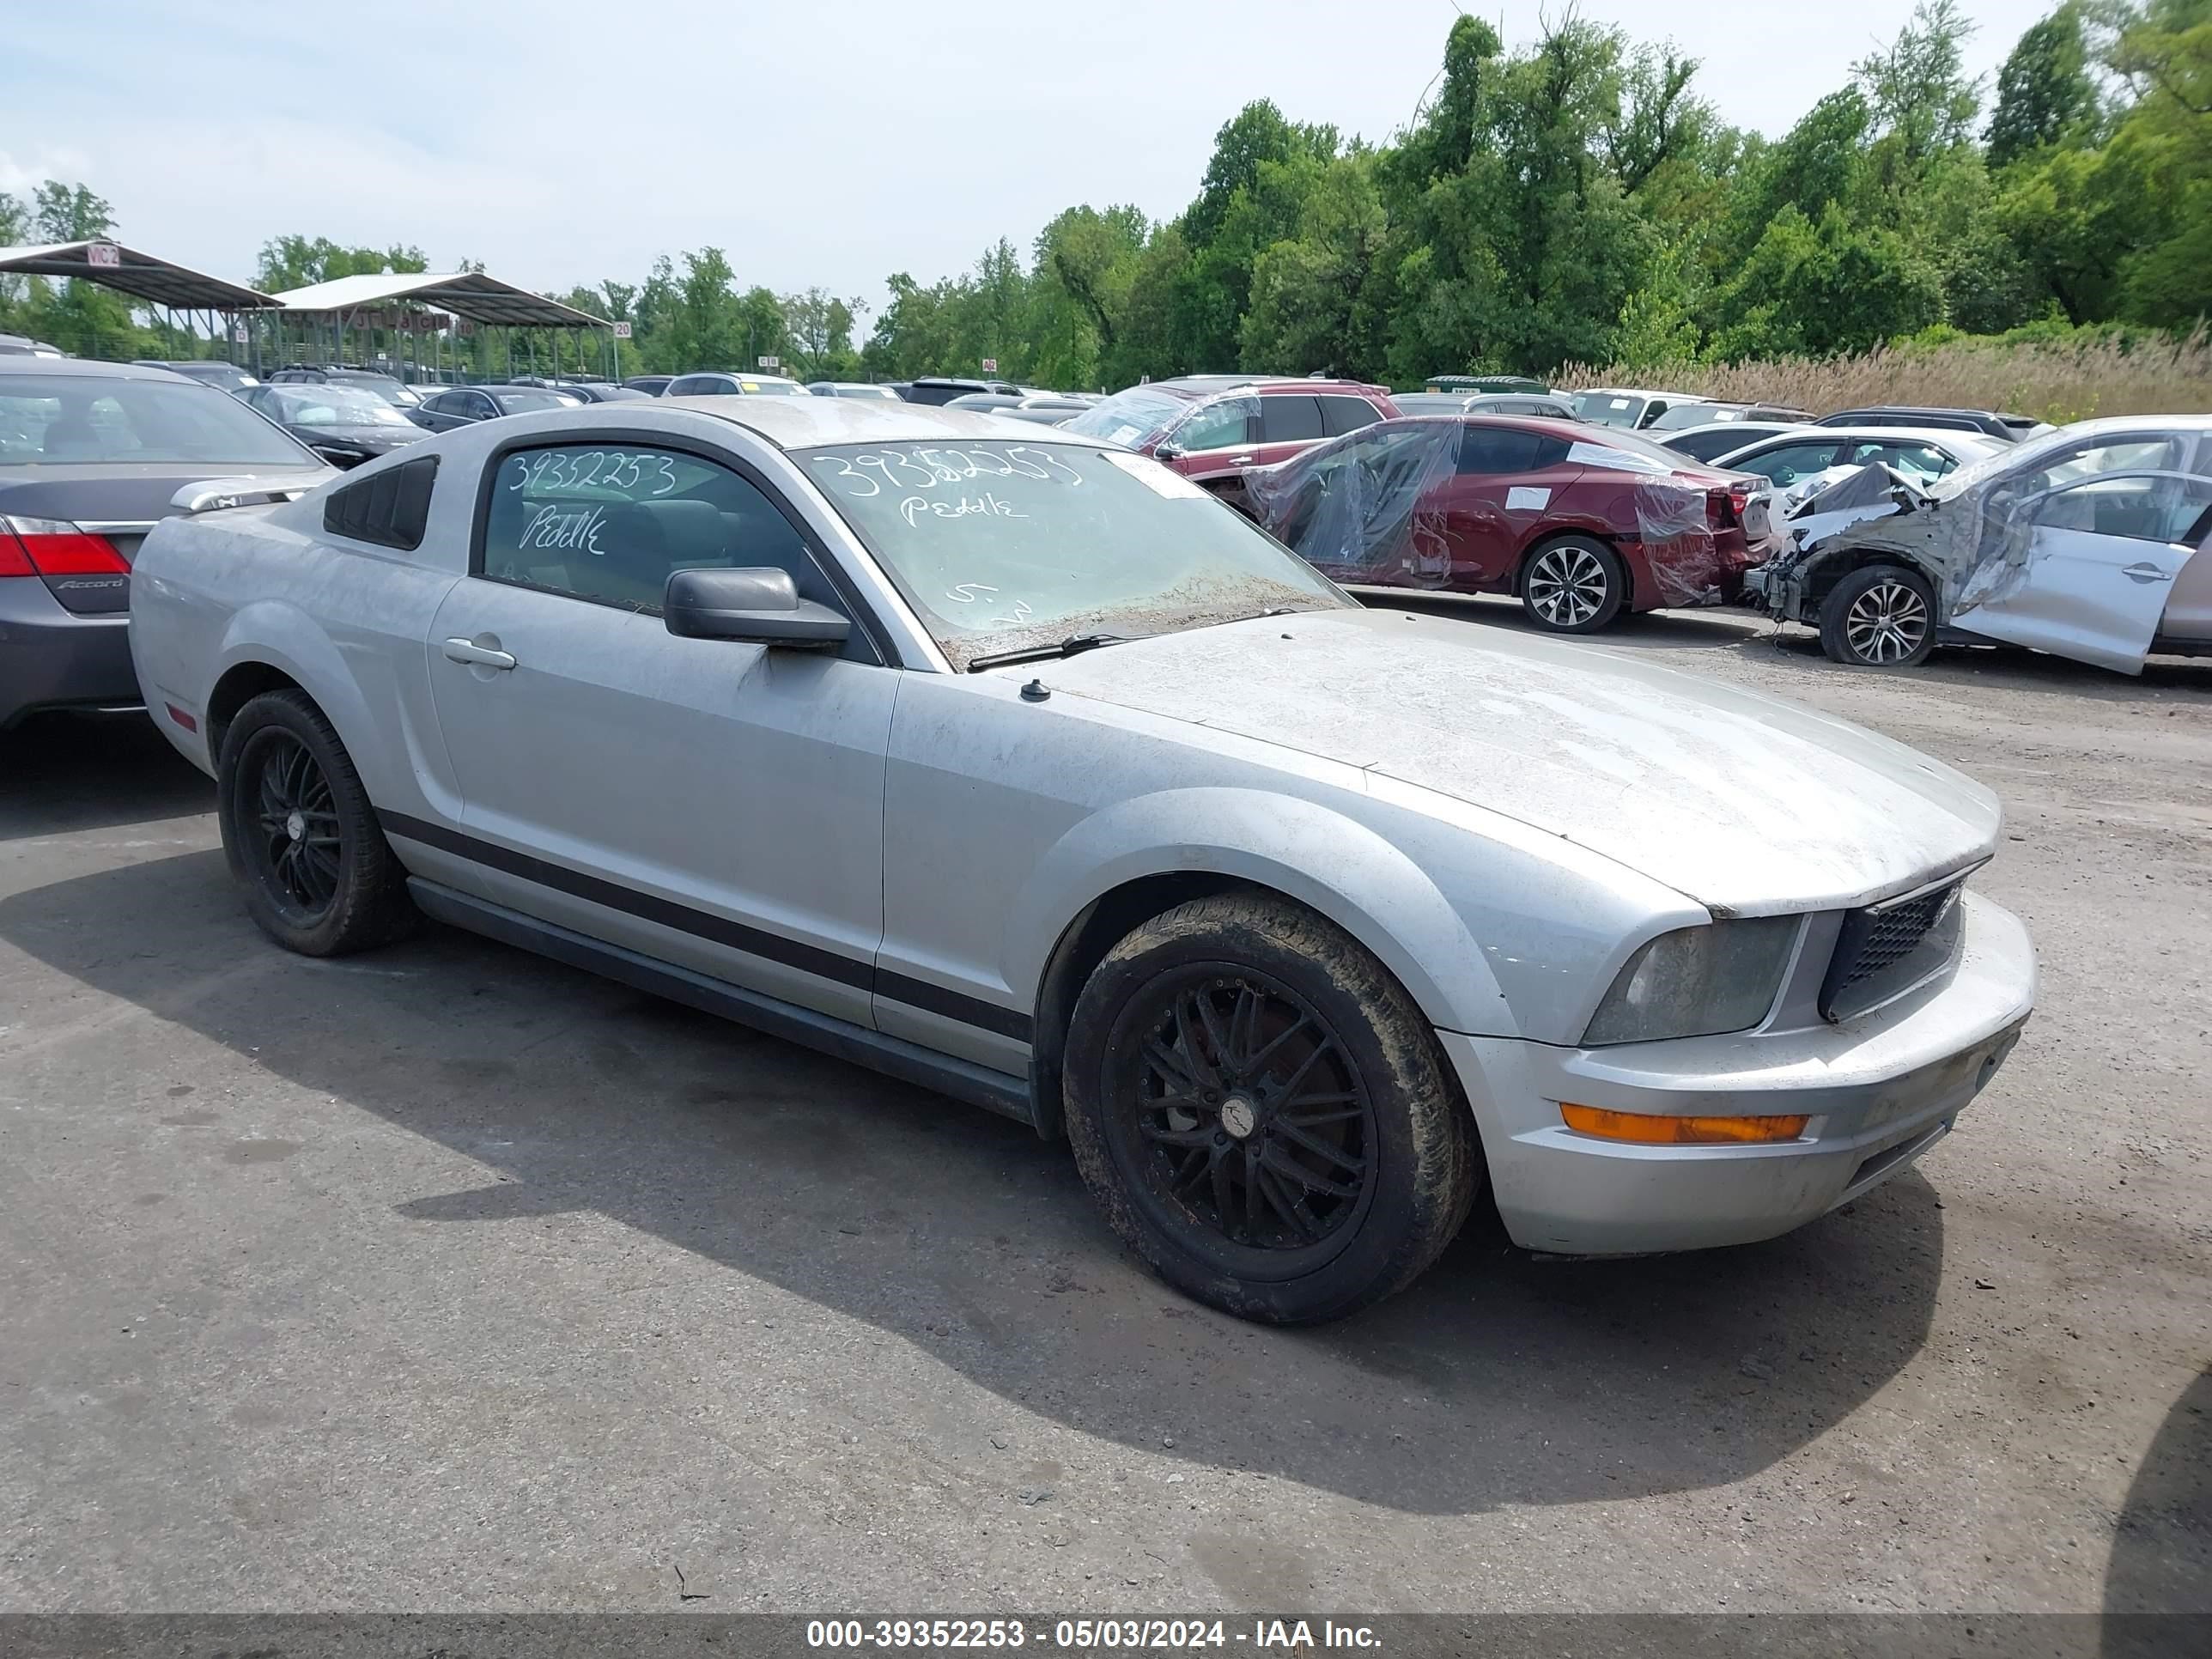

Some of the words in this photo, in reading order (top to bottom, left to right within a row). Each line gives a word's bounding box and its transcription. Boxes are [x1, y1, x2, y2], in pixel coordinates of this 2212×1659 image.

[617, 324, 629, 335] 20
[509, 451, 676, 495] 39352253
[812, 447, 1083, 496] 39352253
[57, 579, 124, 590] Accord
